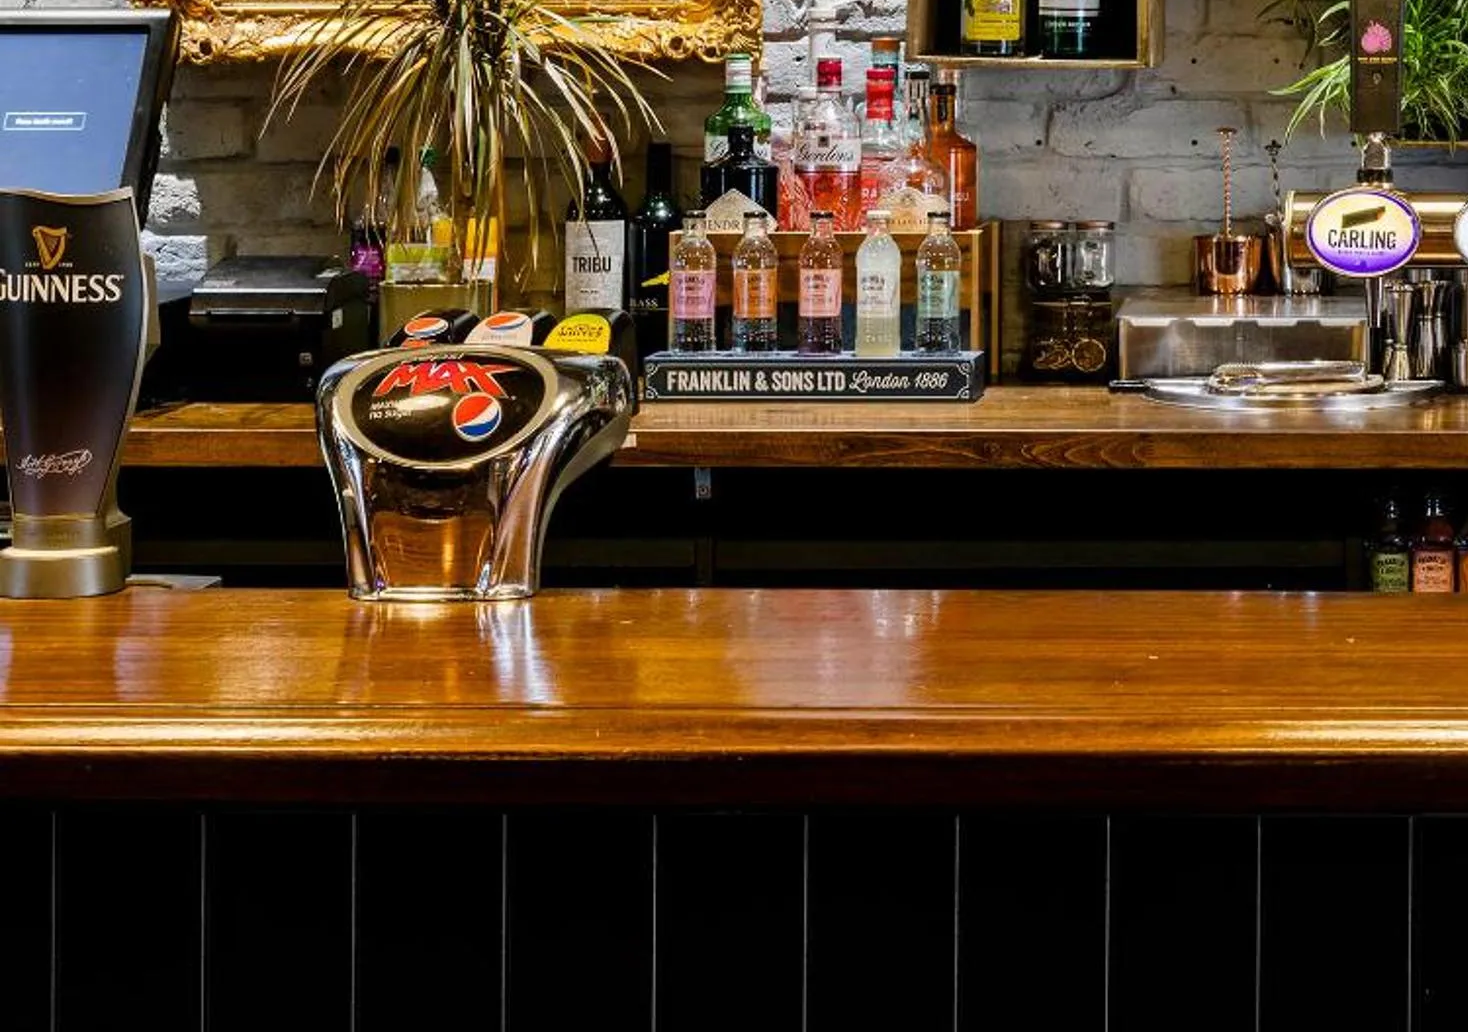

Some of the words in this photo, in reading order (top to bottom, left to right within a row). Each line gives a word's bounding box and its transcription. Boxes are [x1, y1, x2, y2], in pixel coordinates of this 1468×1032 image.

[1328, 229, 1397, 250] CARLING
[572, 256, 612, 273] TRIBU
[373, 360, 520, 398] MAX
[667, 371, 750, 391] FRANKLIN
[754, 371, 769, 391] &
[772, 371, 814, 391] SONS
[818, 371, 846, 391] LTD
[850, 370, 911, 393] London
[914, 370, 950, 389] 1886
